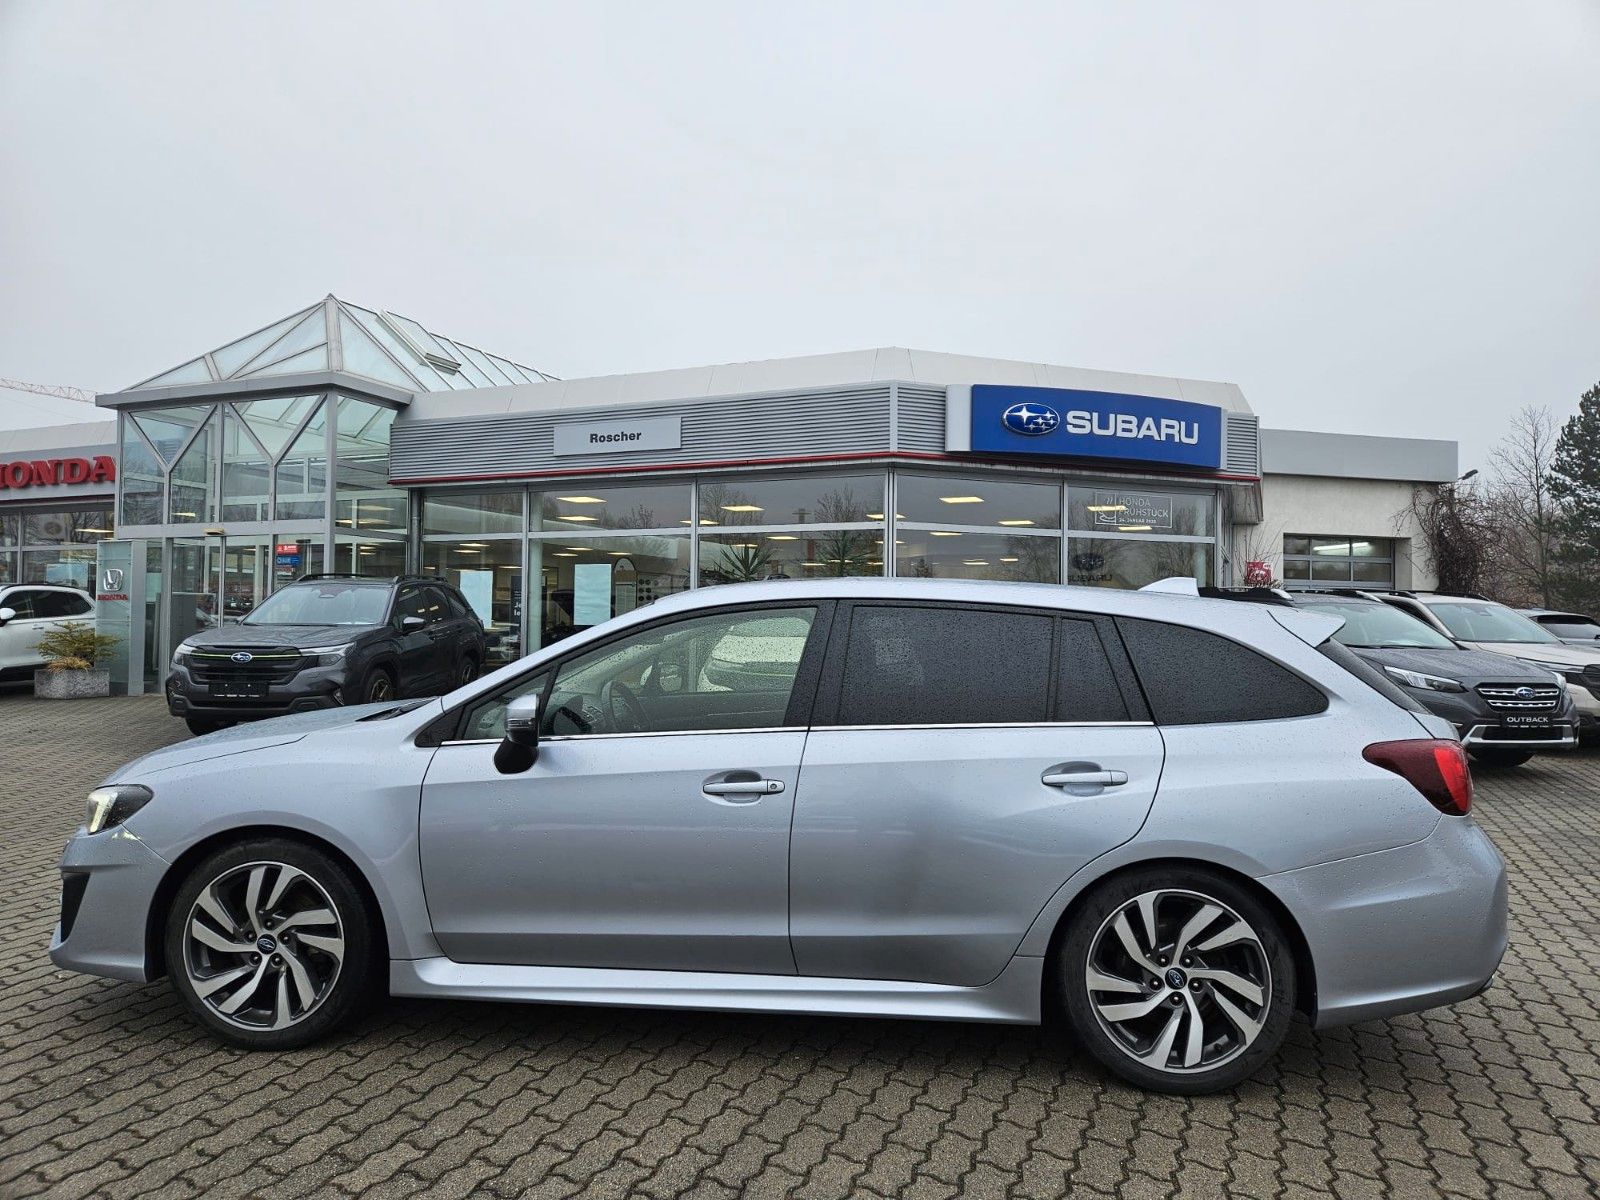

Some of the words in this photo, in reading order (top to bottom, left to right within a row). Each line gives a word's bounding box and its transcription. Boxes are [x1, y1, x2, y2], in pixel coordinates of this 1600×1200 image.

[590, 431, 642, 443] Roscher
[1066, 410, 1198, 445] SUBARU
[0, 456, 116, 490] ONDA
[1119, 497, 1151, 507] HONDA
